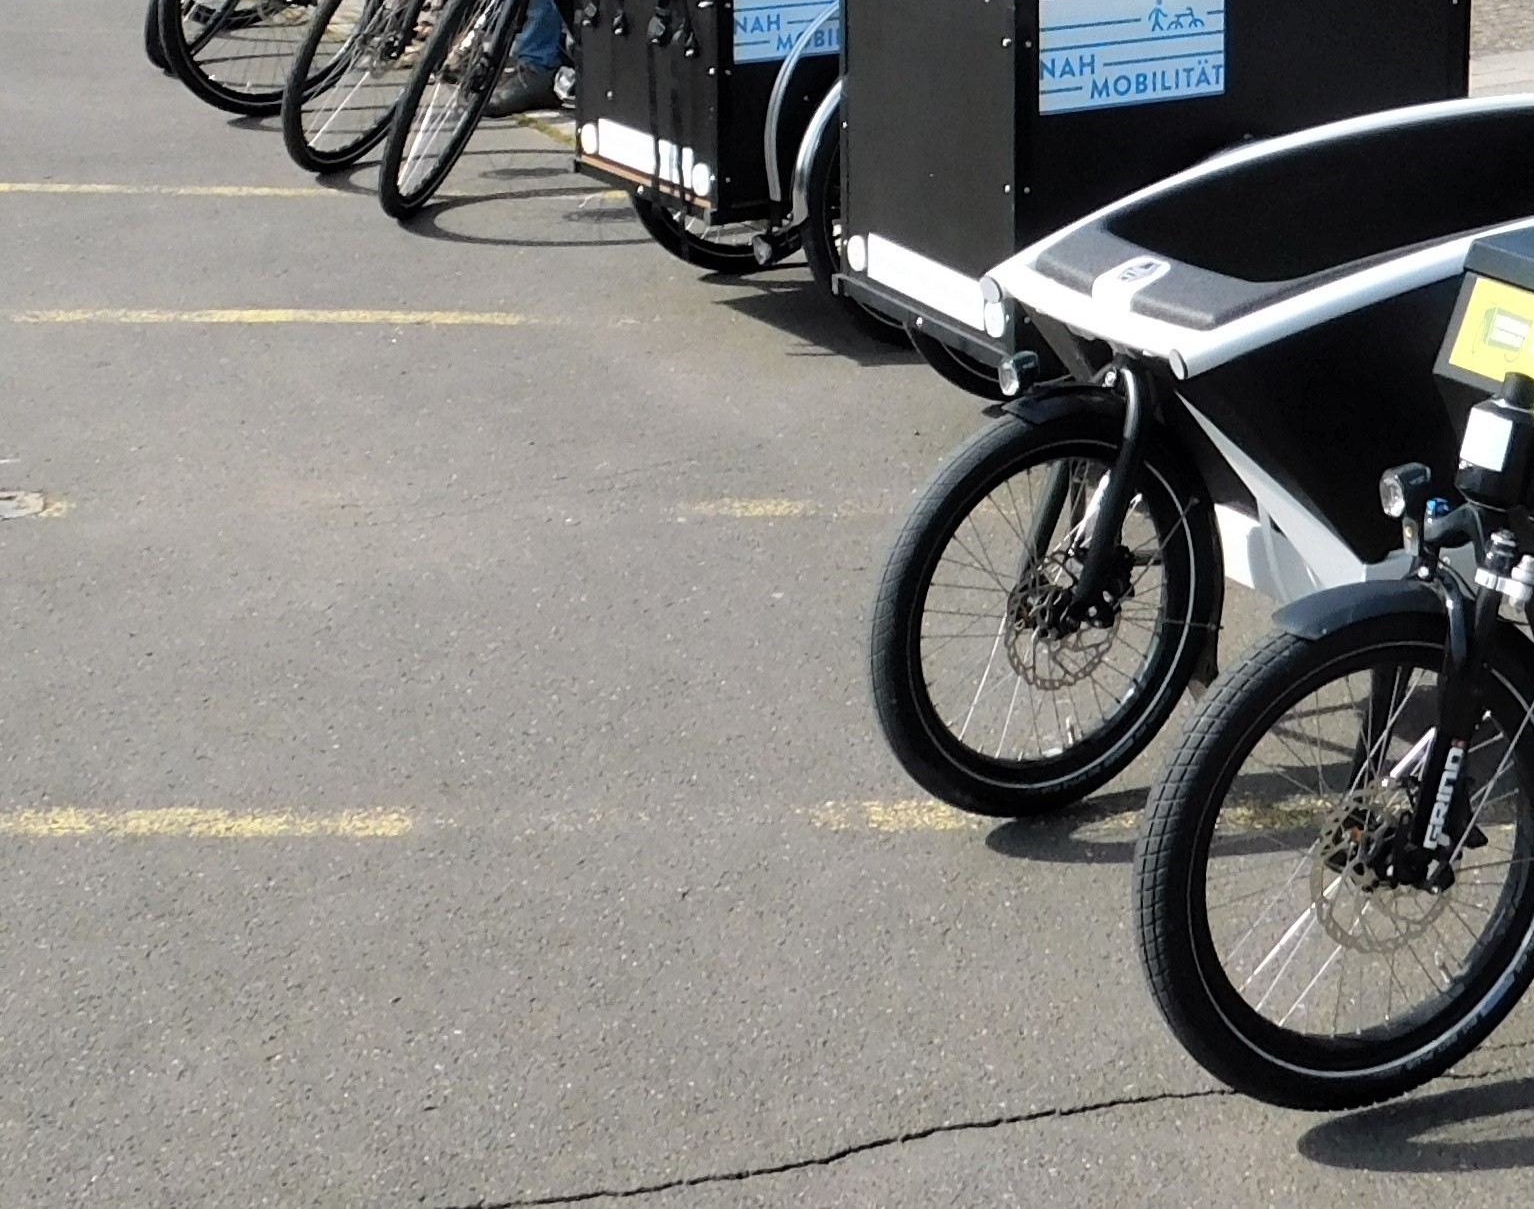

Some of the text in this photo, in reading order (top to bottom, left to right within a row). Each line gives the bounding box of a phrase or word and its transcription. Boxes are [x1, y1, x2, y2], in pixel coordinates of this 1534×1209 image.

[734, 13, 781, 36] NAH
[1040, 54, 1096, 81] NAH
[1090, 59, 1224, 100] MOBILITÄT
